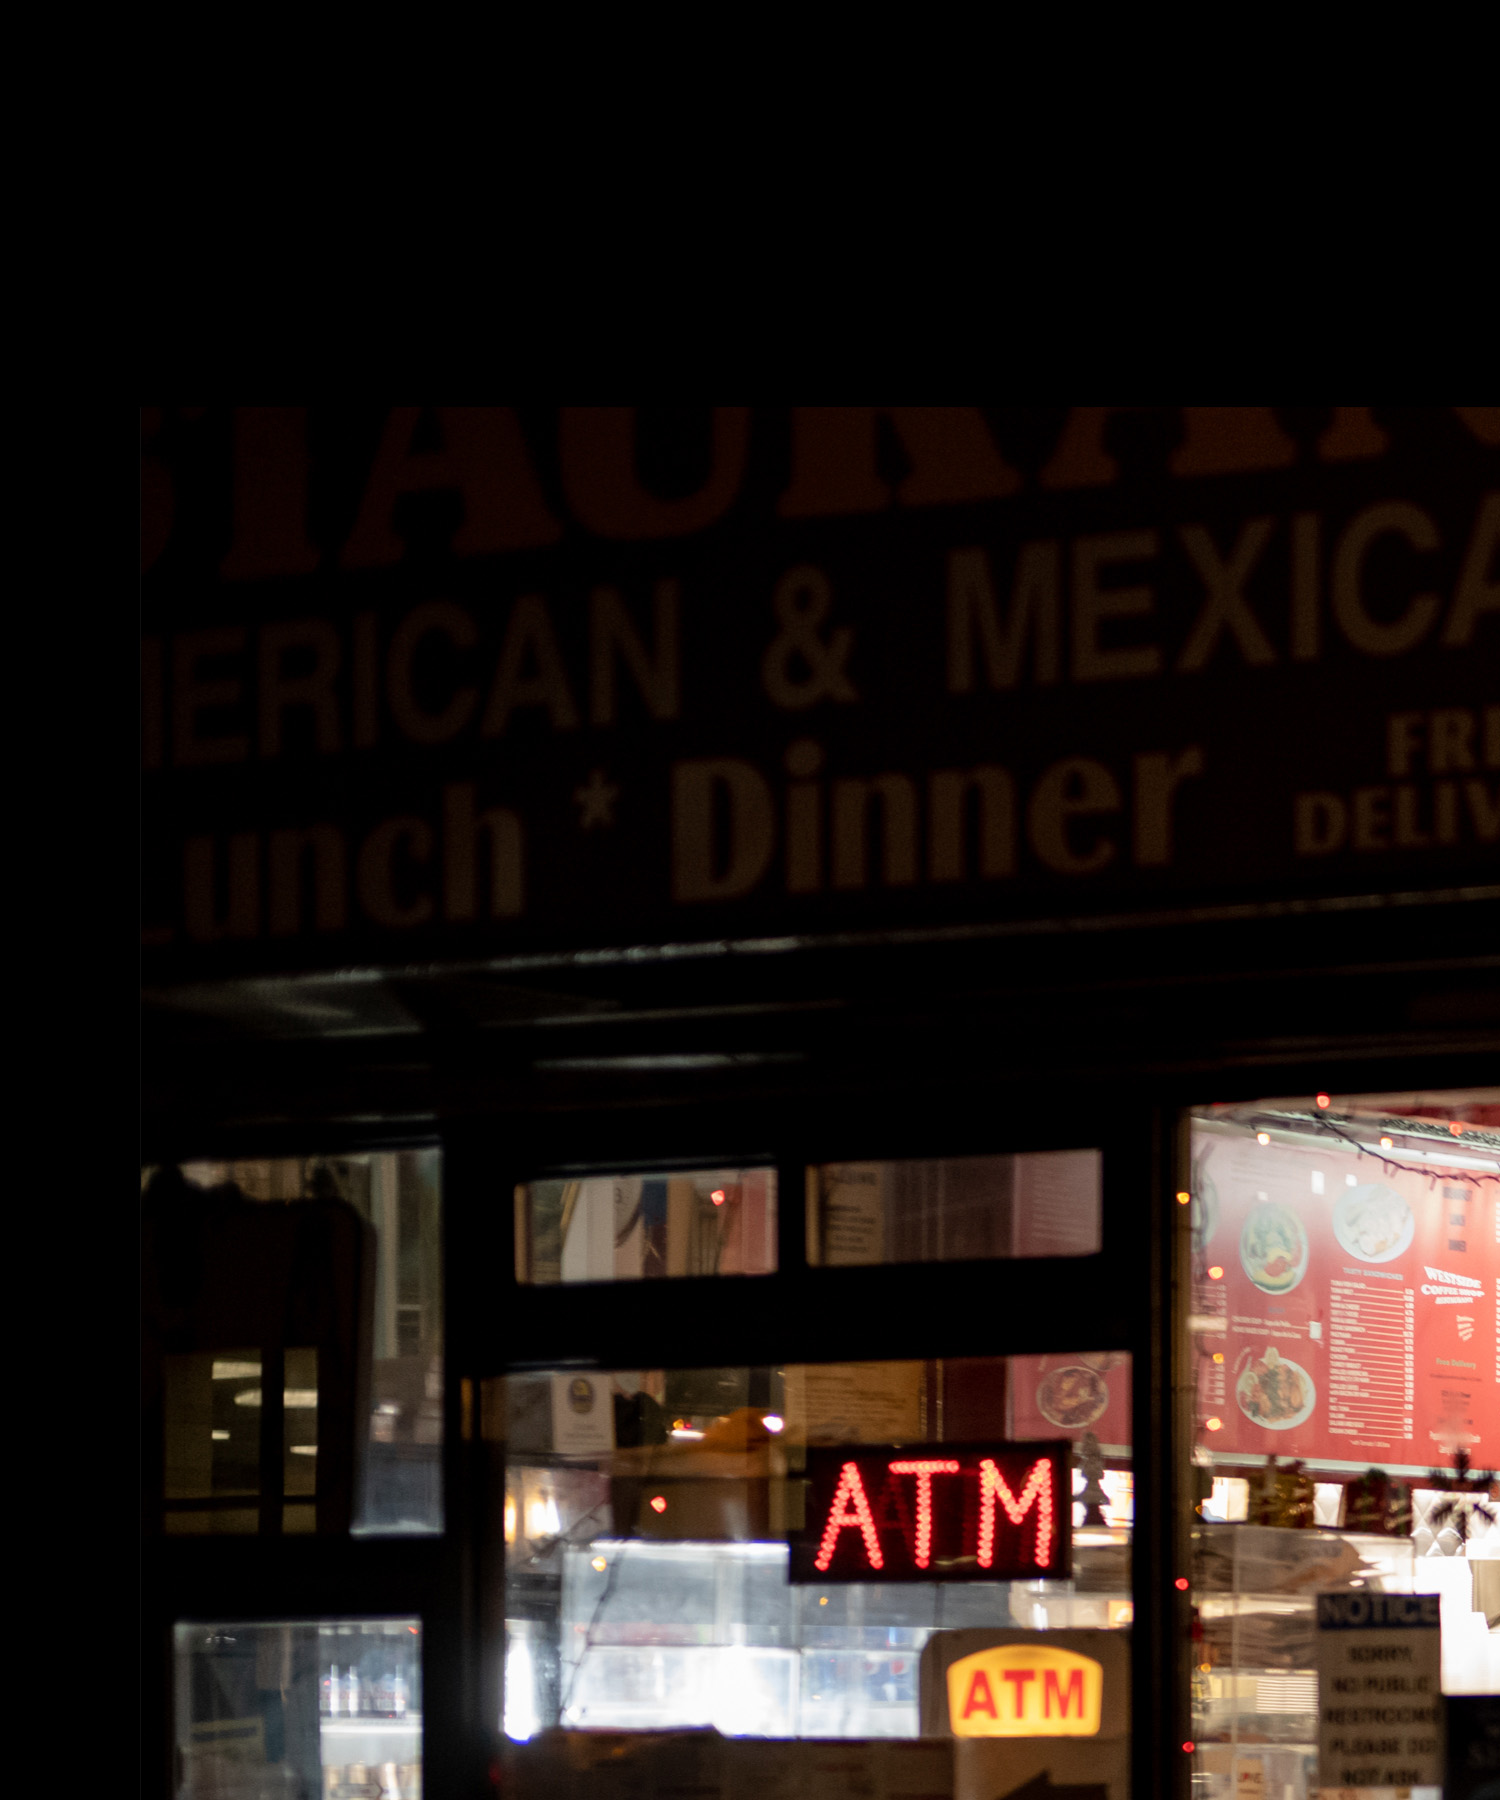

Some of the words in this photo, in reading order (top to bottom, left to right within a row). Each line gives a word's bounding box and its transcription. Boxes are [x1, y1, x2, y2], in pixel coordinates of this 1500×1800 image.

[142, 578, 682, 769] ERICAN
[760, 564, 861, 711] &
[142, 781, 527, 948] unch
[668, 737, 1204, 904] Dinner
[1423, 1265, 1483, 1289] WESTSIDE
[814, 1458, 1053, 1571] ATM
[1318, 1594, 1439, 1626] NOTICE
[961, 1668, 1085, 1719] ATM
